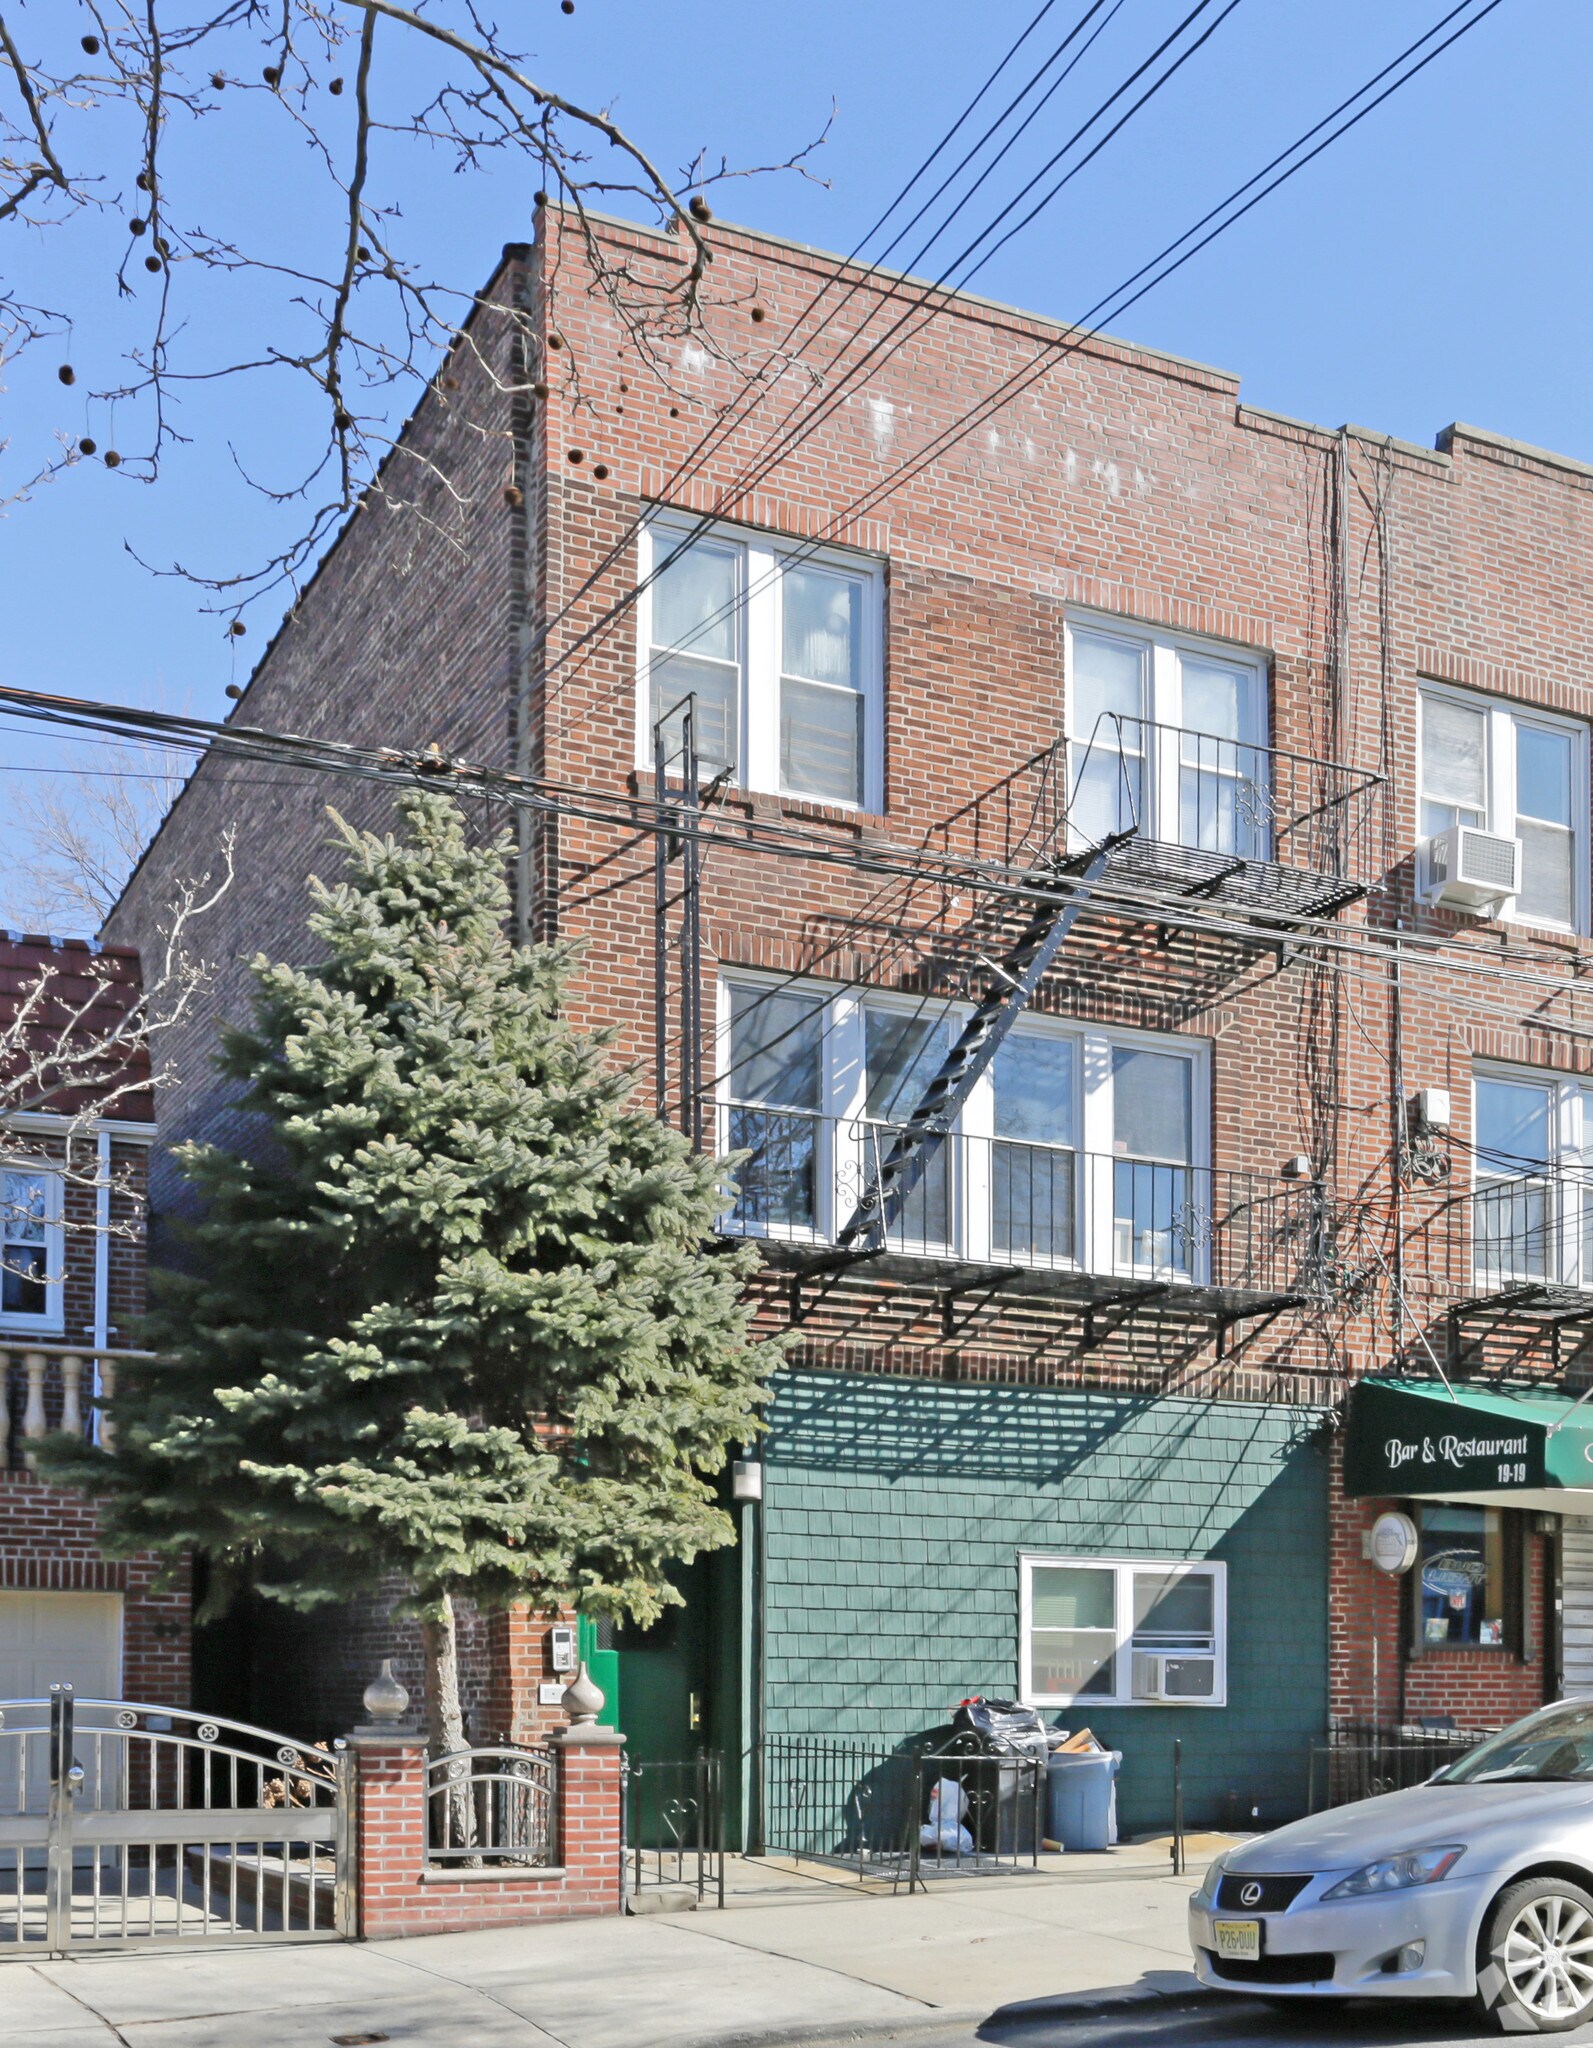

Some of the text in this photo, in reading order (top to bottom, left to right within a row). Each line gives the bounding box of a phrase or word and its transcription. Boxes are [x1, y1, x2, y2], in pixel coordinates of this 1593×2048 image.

[1385, 1434, 1528, 1468] Bar & Restaurant
[1497, 1463, 1526, 1482] 19-19
[1438, 1558, 1485, 1573] BUD
